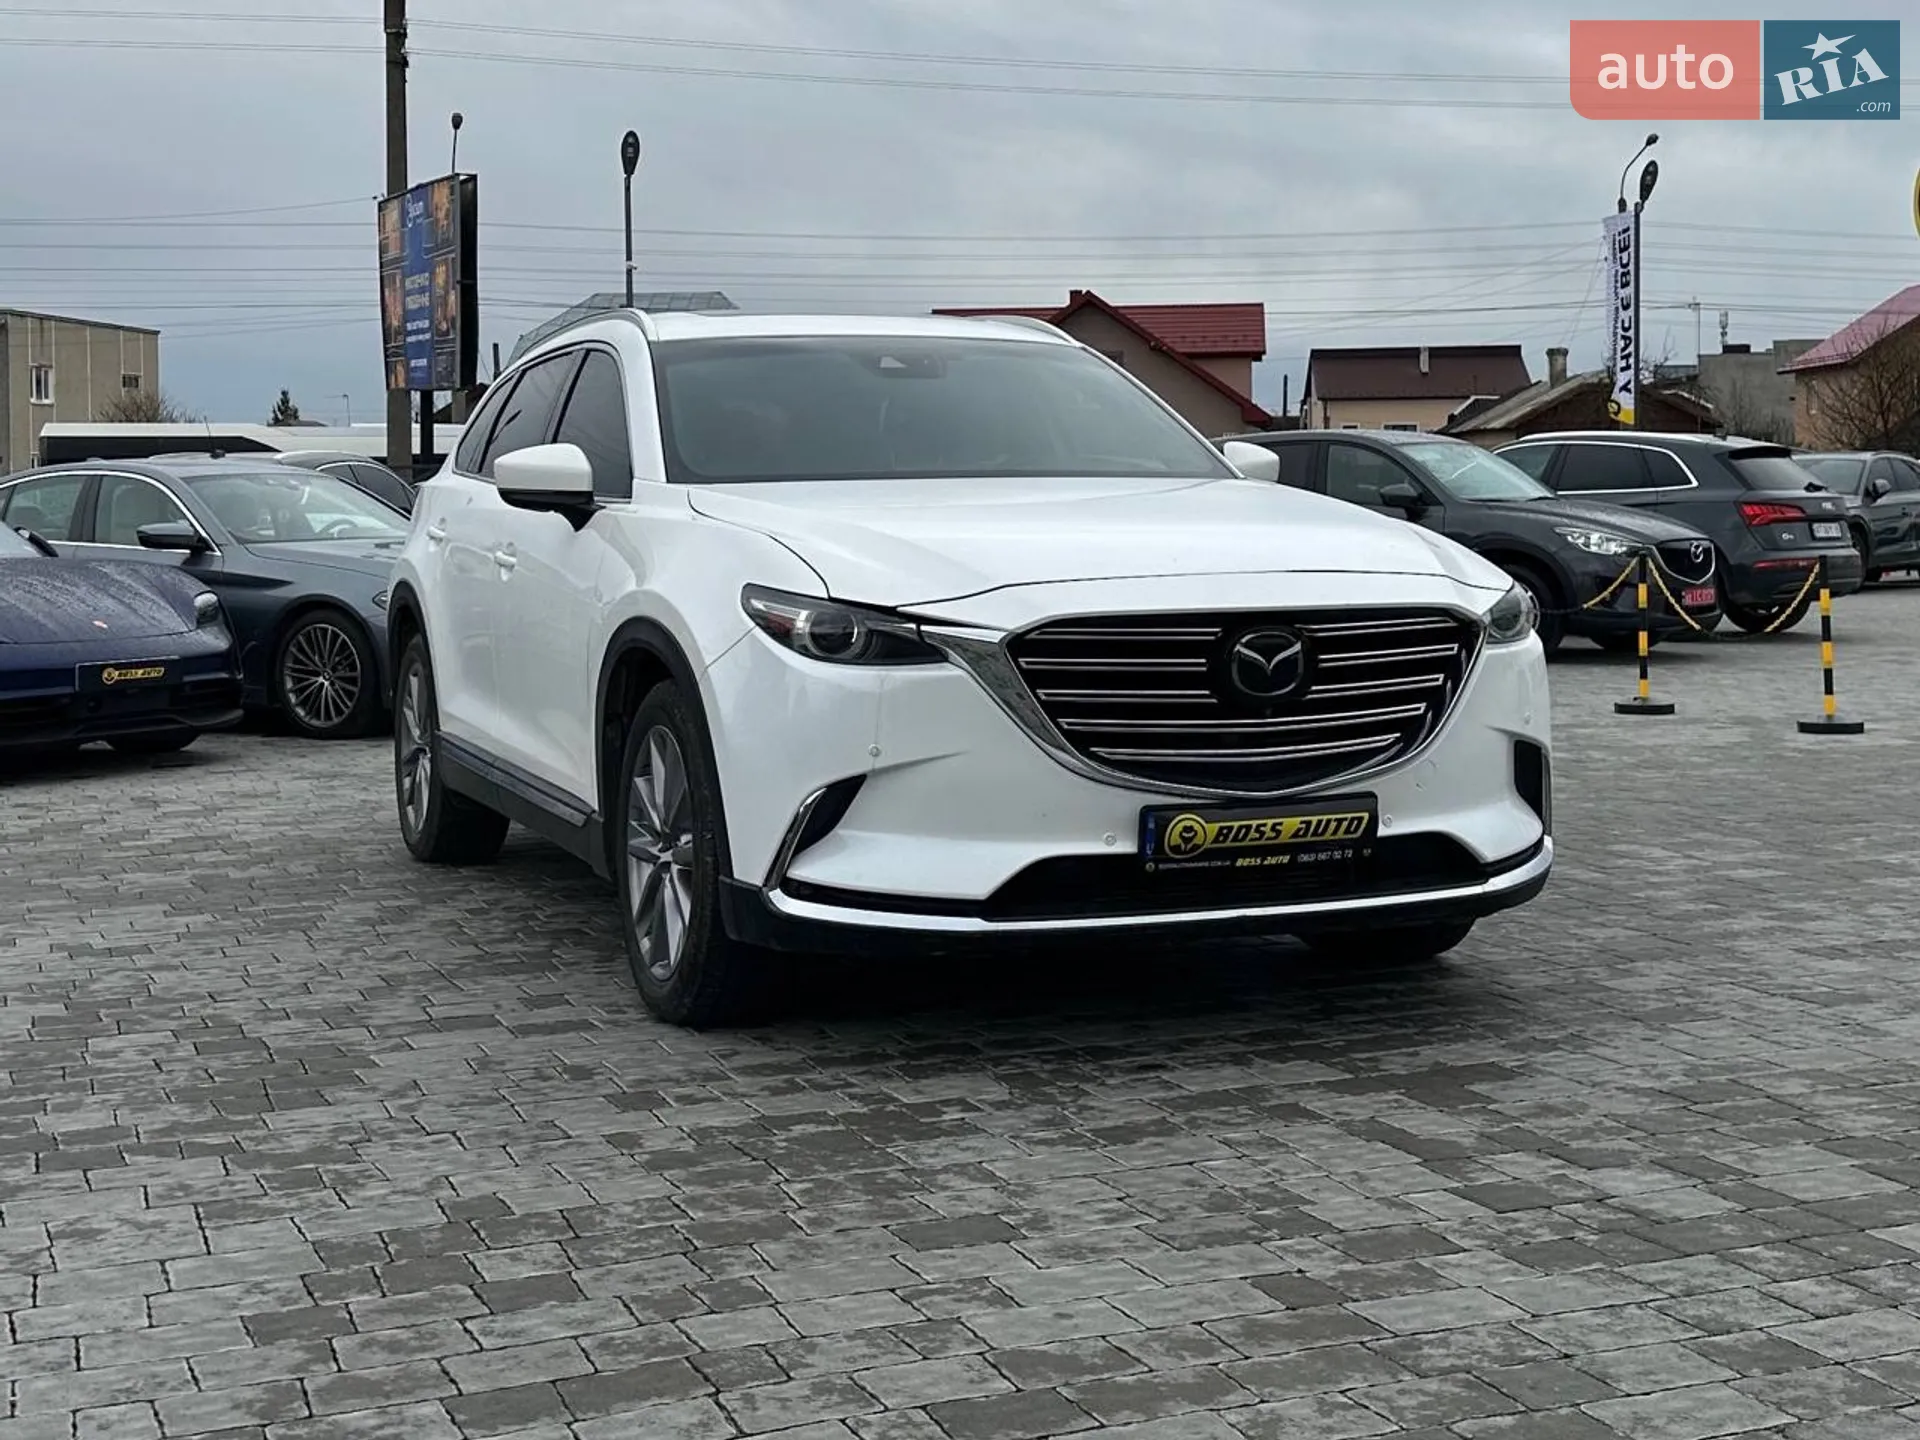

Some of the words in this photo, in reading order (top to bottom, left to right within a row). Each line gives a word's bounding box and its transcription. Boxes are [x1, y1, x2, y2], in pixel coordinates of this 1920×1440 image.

[1211, 821, 1285, 845] BOSS
[1289, 815, 1366, 840] AUTO
[1236, 857, 1261, 866] BOSS
[1263, 855, 1290, 865] AUTO
